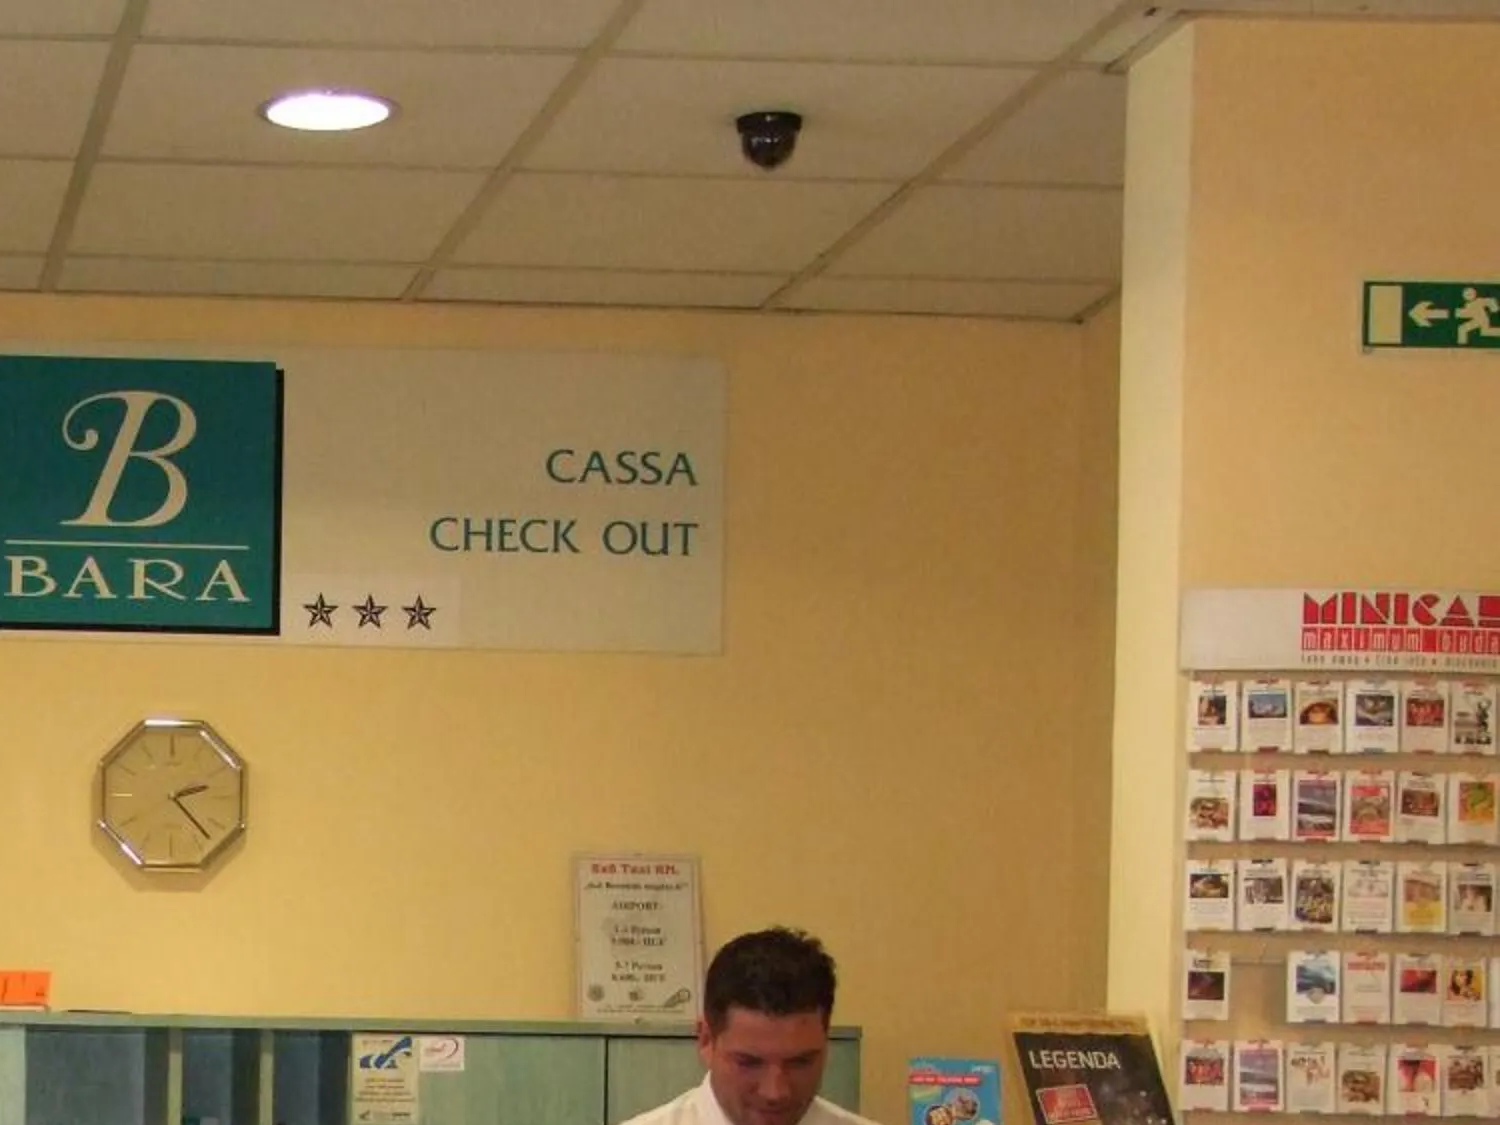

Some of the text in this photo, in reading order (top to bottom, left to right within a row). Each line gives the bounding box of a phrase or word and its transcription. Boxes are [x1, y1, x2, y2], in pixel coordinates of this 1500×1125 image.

[546, 448, 699, 486] CASSA
[429, 516, 699, 557] CHECK OUT
[3, 554, 251, 603] BARA
[1028, 1049, 1123, 1072] LEGENDA
